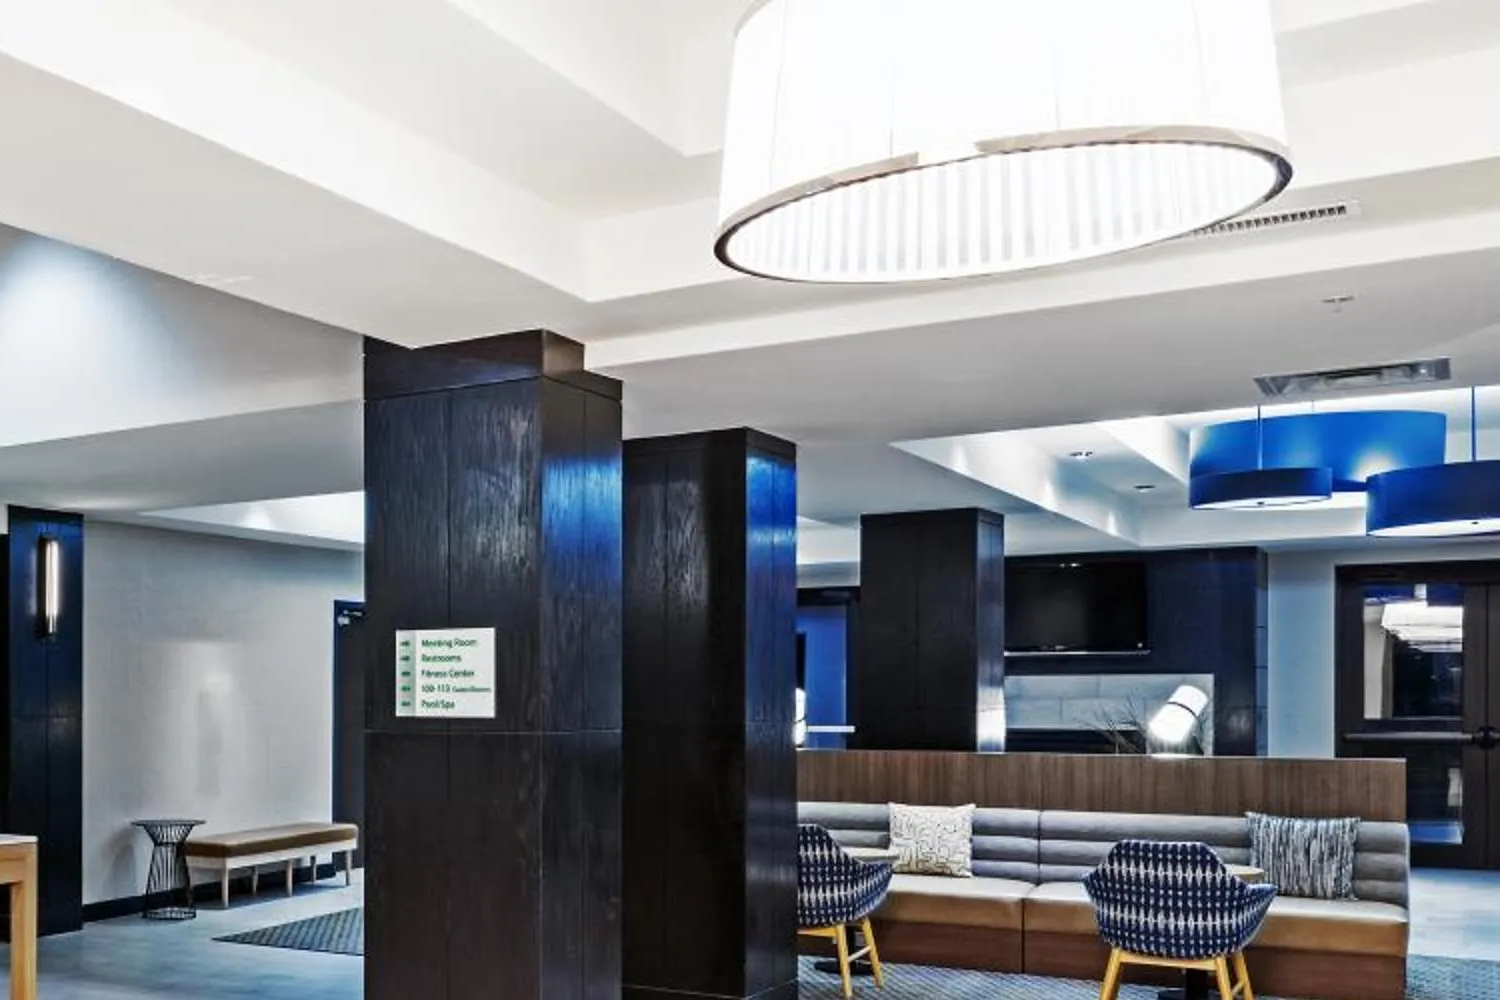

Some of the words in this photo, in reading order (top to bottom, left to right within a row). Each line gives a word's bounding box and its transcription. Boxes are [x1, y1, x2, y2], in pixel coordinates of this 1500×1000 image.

[421, 639, 452, 648] Meeting
[453, 638, 477, 646] Room
[421, 654, 462, 662] Restrooms
[421, 669, 446, 677] Fitness
[448, 668, 475, 677] Center
